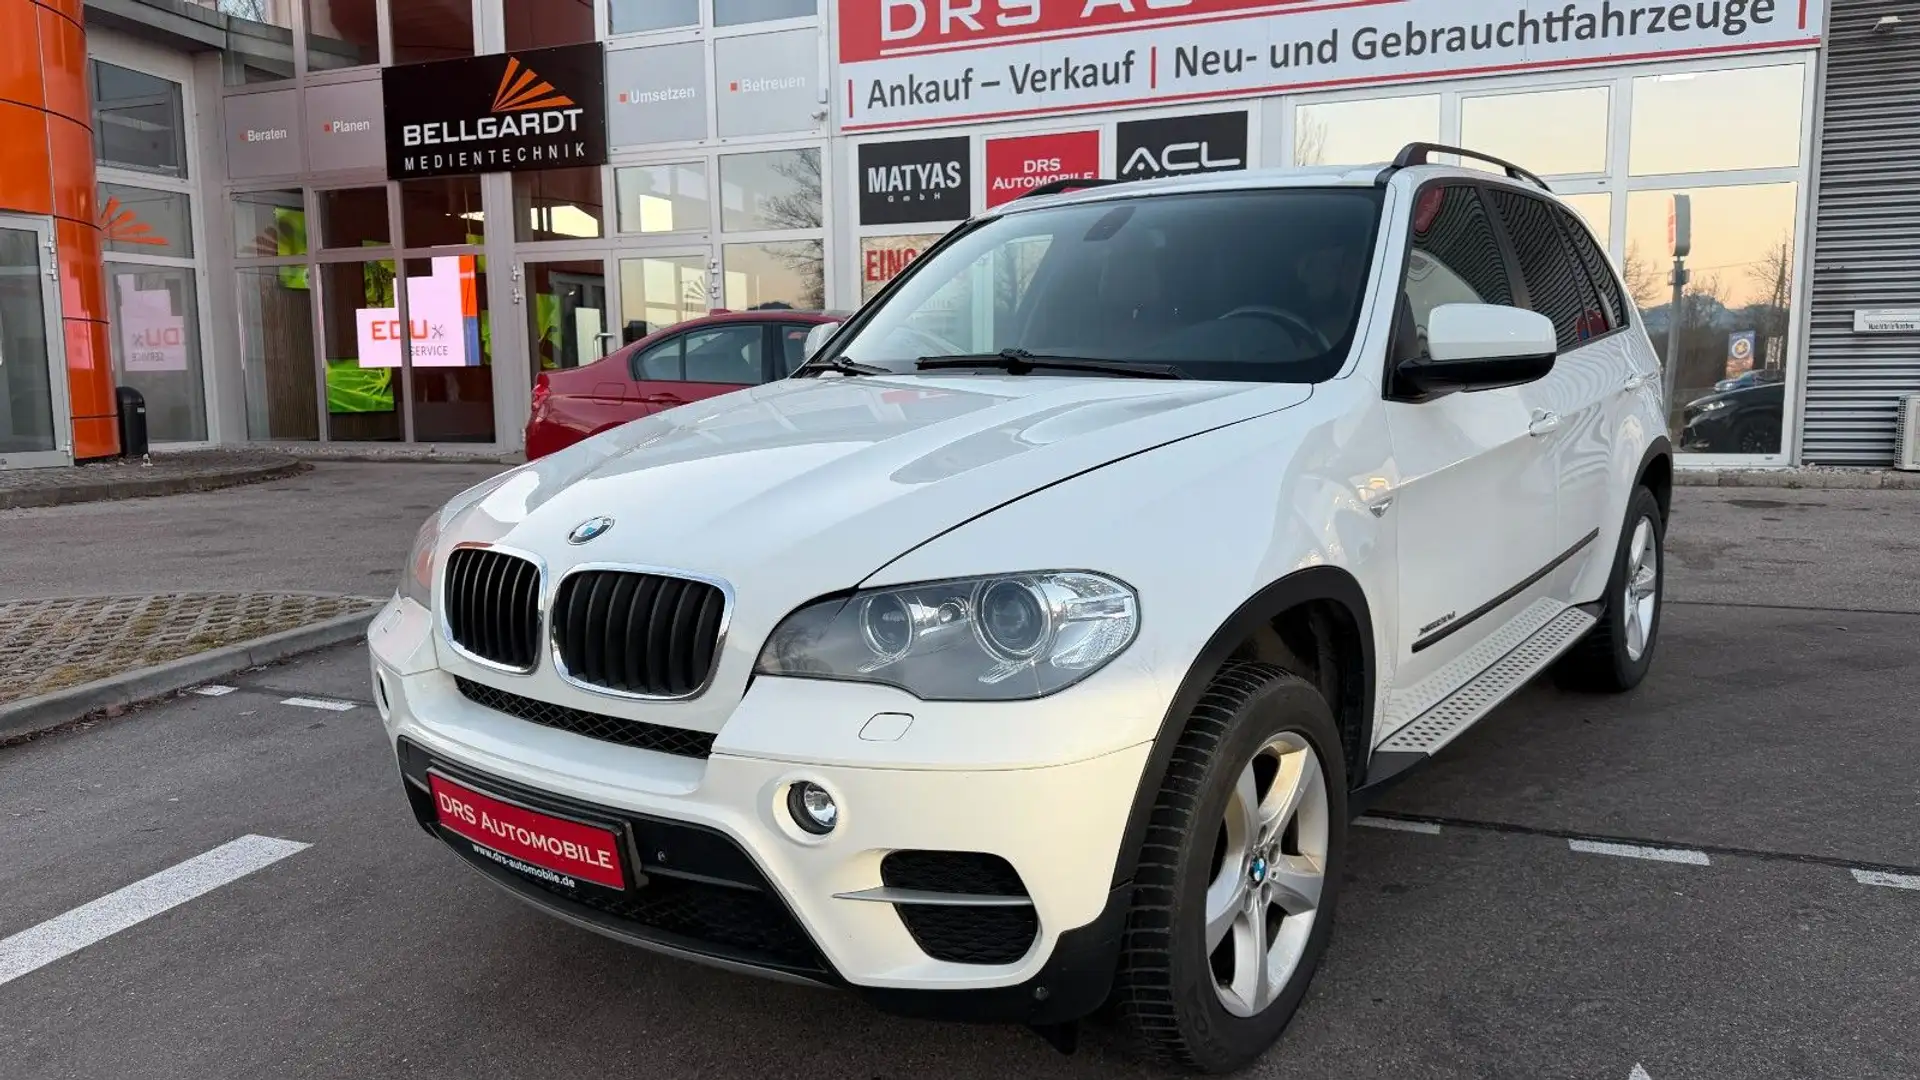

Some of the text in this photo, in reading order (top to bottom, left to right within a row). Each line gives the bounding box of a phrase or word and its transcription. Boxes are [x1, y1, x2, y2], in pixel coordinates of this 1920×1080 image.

[881, 0, 1041, 41] DRS
[1174, 0, 1775, 78] Neu- und Gebrauchtfahrzeuge
[630, 86, 695, 104] Umsetzen
[741, 76, 806, 93] Betreuen
[868, 68, 974, 109] Ankauf
[1009, 50, 1135, 95] Verkauf
[247, 129, 288, 142] Beraten
[333, 120, 370, 133] Planen
[403, 108, 584, 147] BELLGARDT
[404, 142, 586, 171] MEDIENTECHNIK
[1024, 158, 1062, 174] DRS
[1122, 141, 1241, 175] ACL
[868, 161, 961, 193] MATYAS
[438, 792, 614, 869] DRS AUTOMOBILE
[472, 843, 575, 888] www.drs-automobile.de
